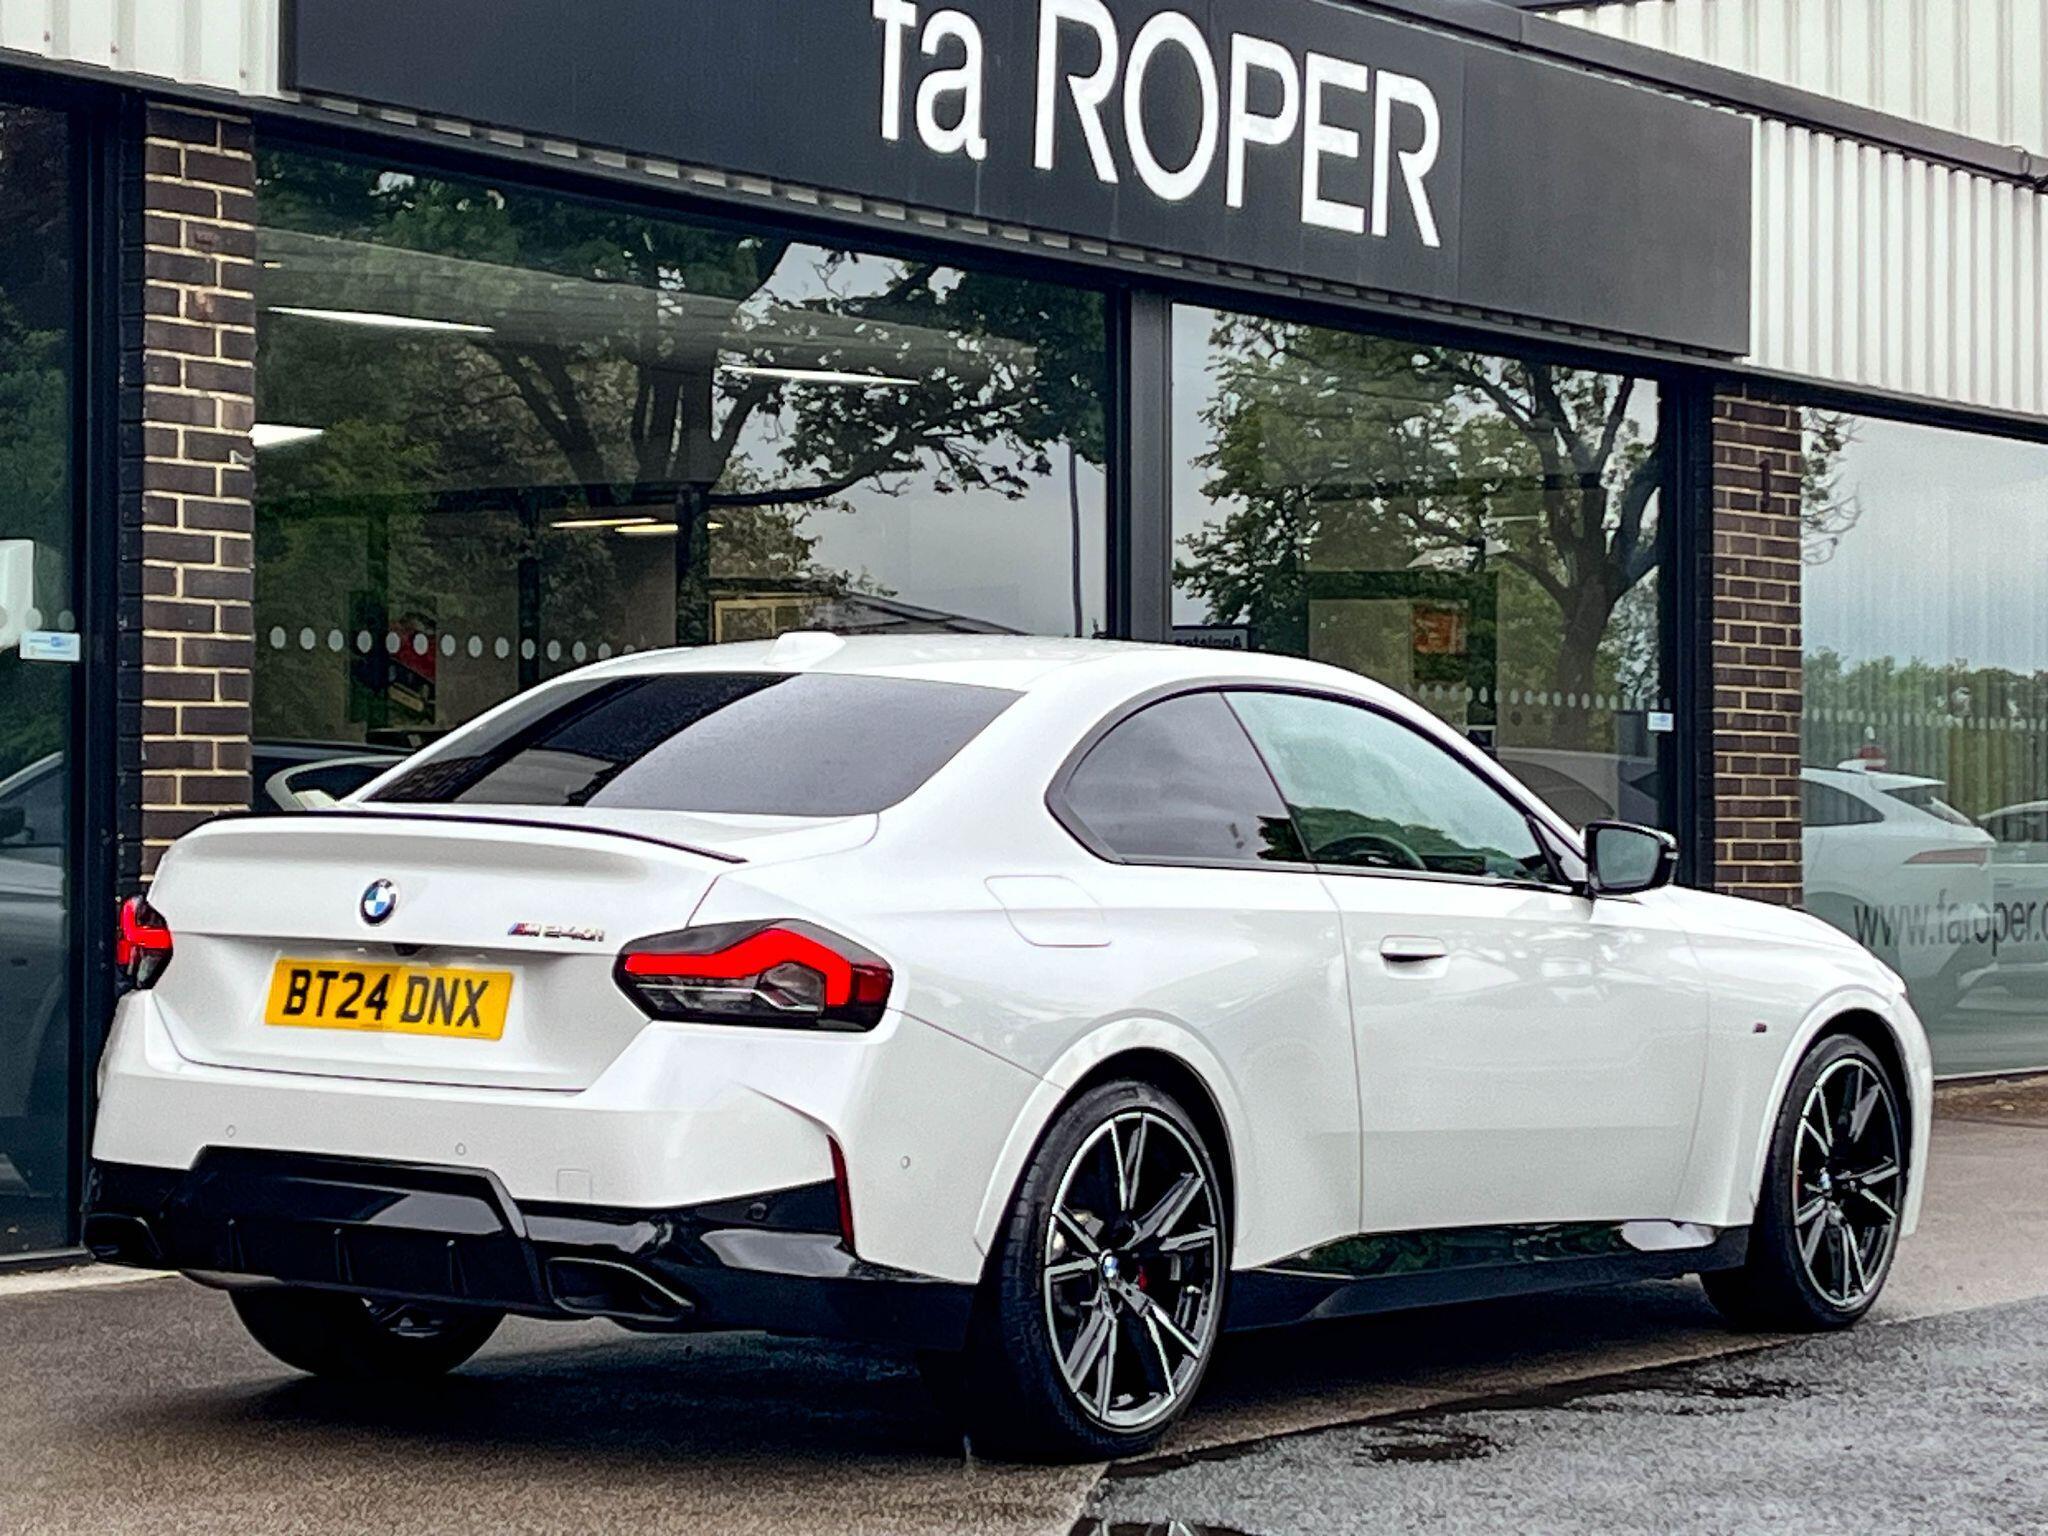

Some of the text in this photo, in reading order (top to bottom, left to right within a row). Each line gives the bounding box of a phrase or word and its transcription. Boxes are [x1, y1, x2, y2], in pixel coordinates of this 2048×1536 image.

[1034, 0, 1441, 248] ROPER
[283, 968, 489, 1028] BT24 DNX
